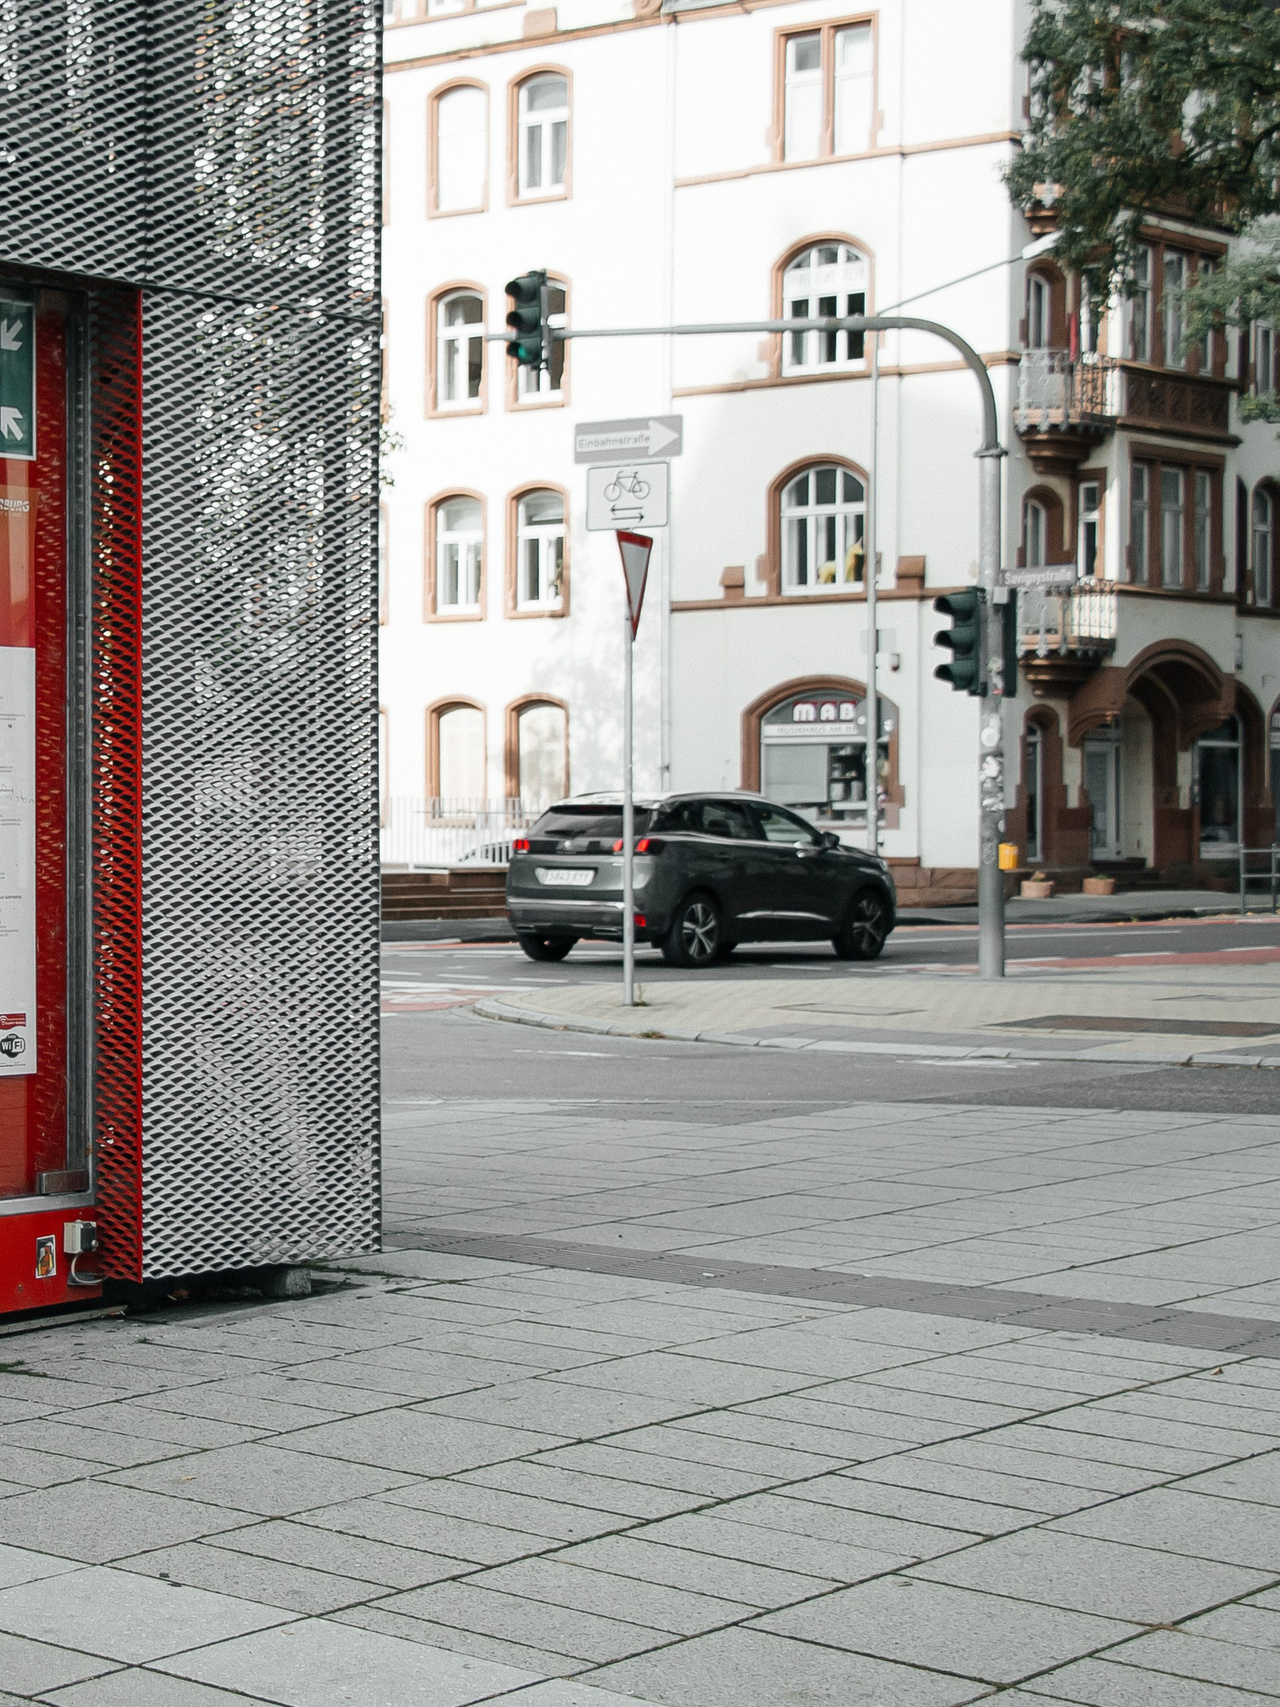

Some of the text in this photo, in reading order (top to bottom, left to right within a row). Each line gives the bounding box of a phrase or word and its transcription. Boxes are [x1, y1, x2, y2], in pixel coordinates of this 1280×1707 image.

[579, 435, 650, 448] Einbahnstraße
[1005, 568, 1071, 586] Savignystraße
[792, 702, 856, 722] MAB
